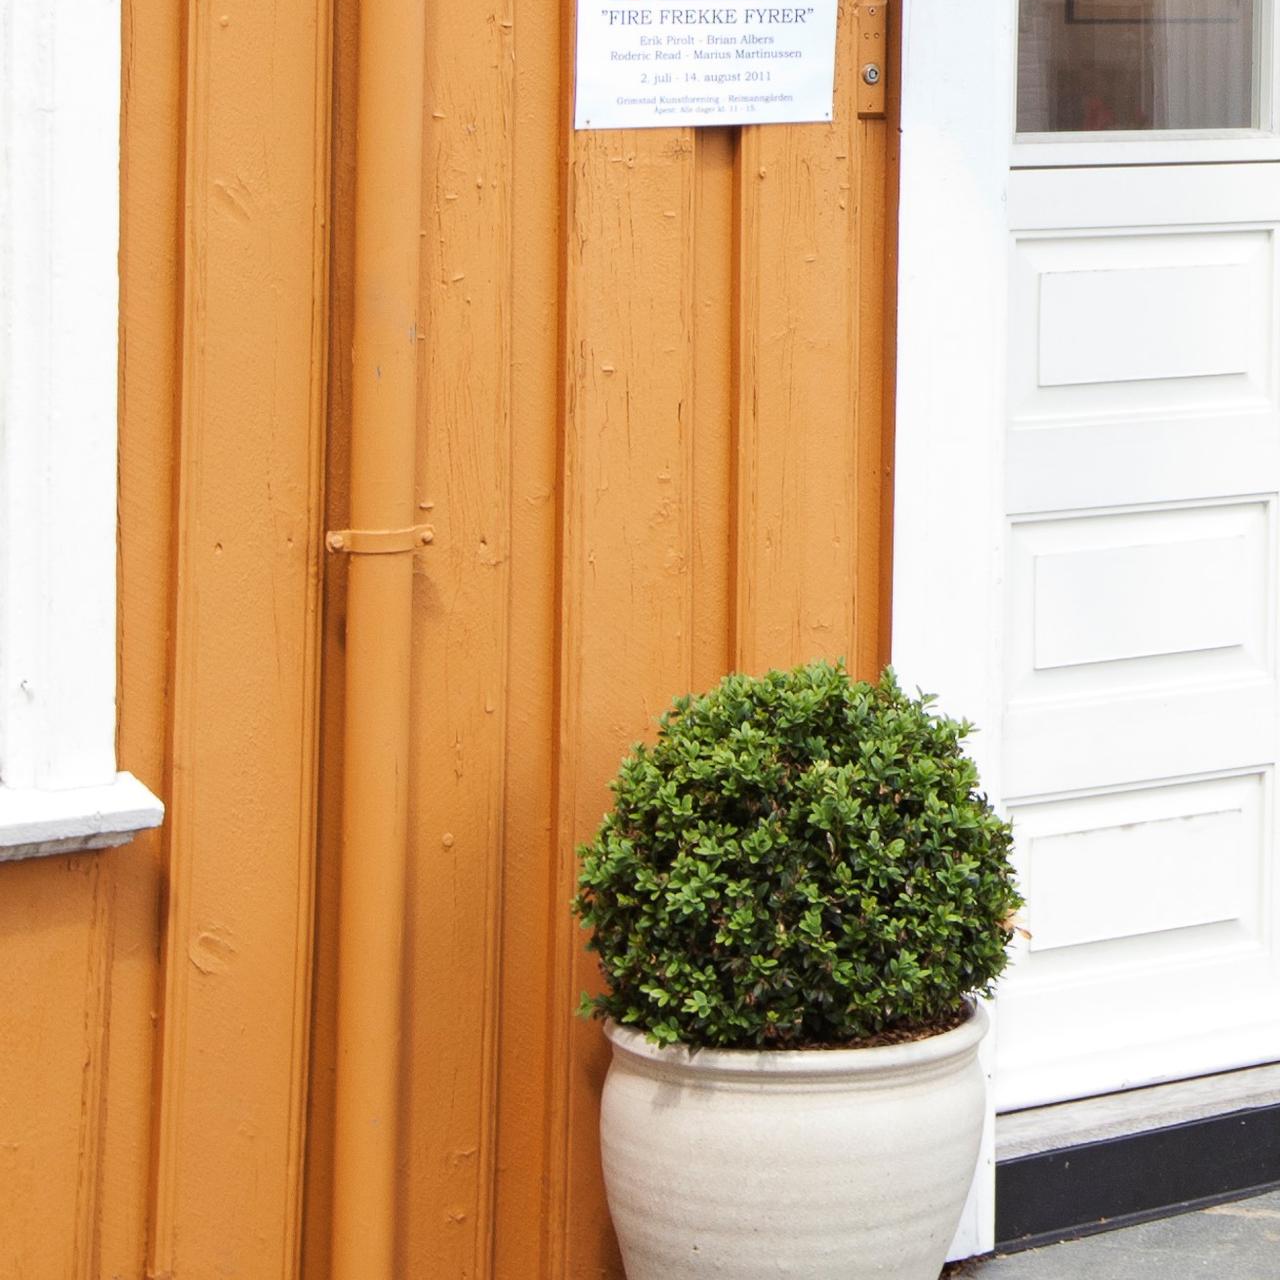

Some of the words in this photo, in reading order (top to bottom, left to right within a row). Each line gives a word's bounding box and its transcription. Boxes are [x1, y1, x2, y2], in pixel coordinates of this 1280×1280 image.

[659, 8, 738, 25] FREKKE
[640, 35, 663, 46] Erik
[666, 35, 695, 46] Pirolt
[707, 34, 737, 45] Brian
[740, 34, 775, 45] Albers
[610, 51, 651, 62] Roderic
[655, 50, 682, 61] Read
[693, 49, 732, 61] Marius
[735, 48, 802, 60] Martinussen
[640, 73, 650, 83] 2.
[653, 73, 672, 86] juli
[684, 72, 700, 83] 14.
[704, 72, 741, 85] august
[744, 71, 772, 82] 2011
[616, 95, 656, 105] Grimstad
